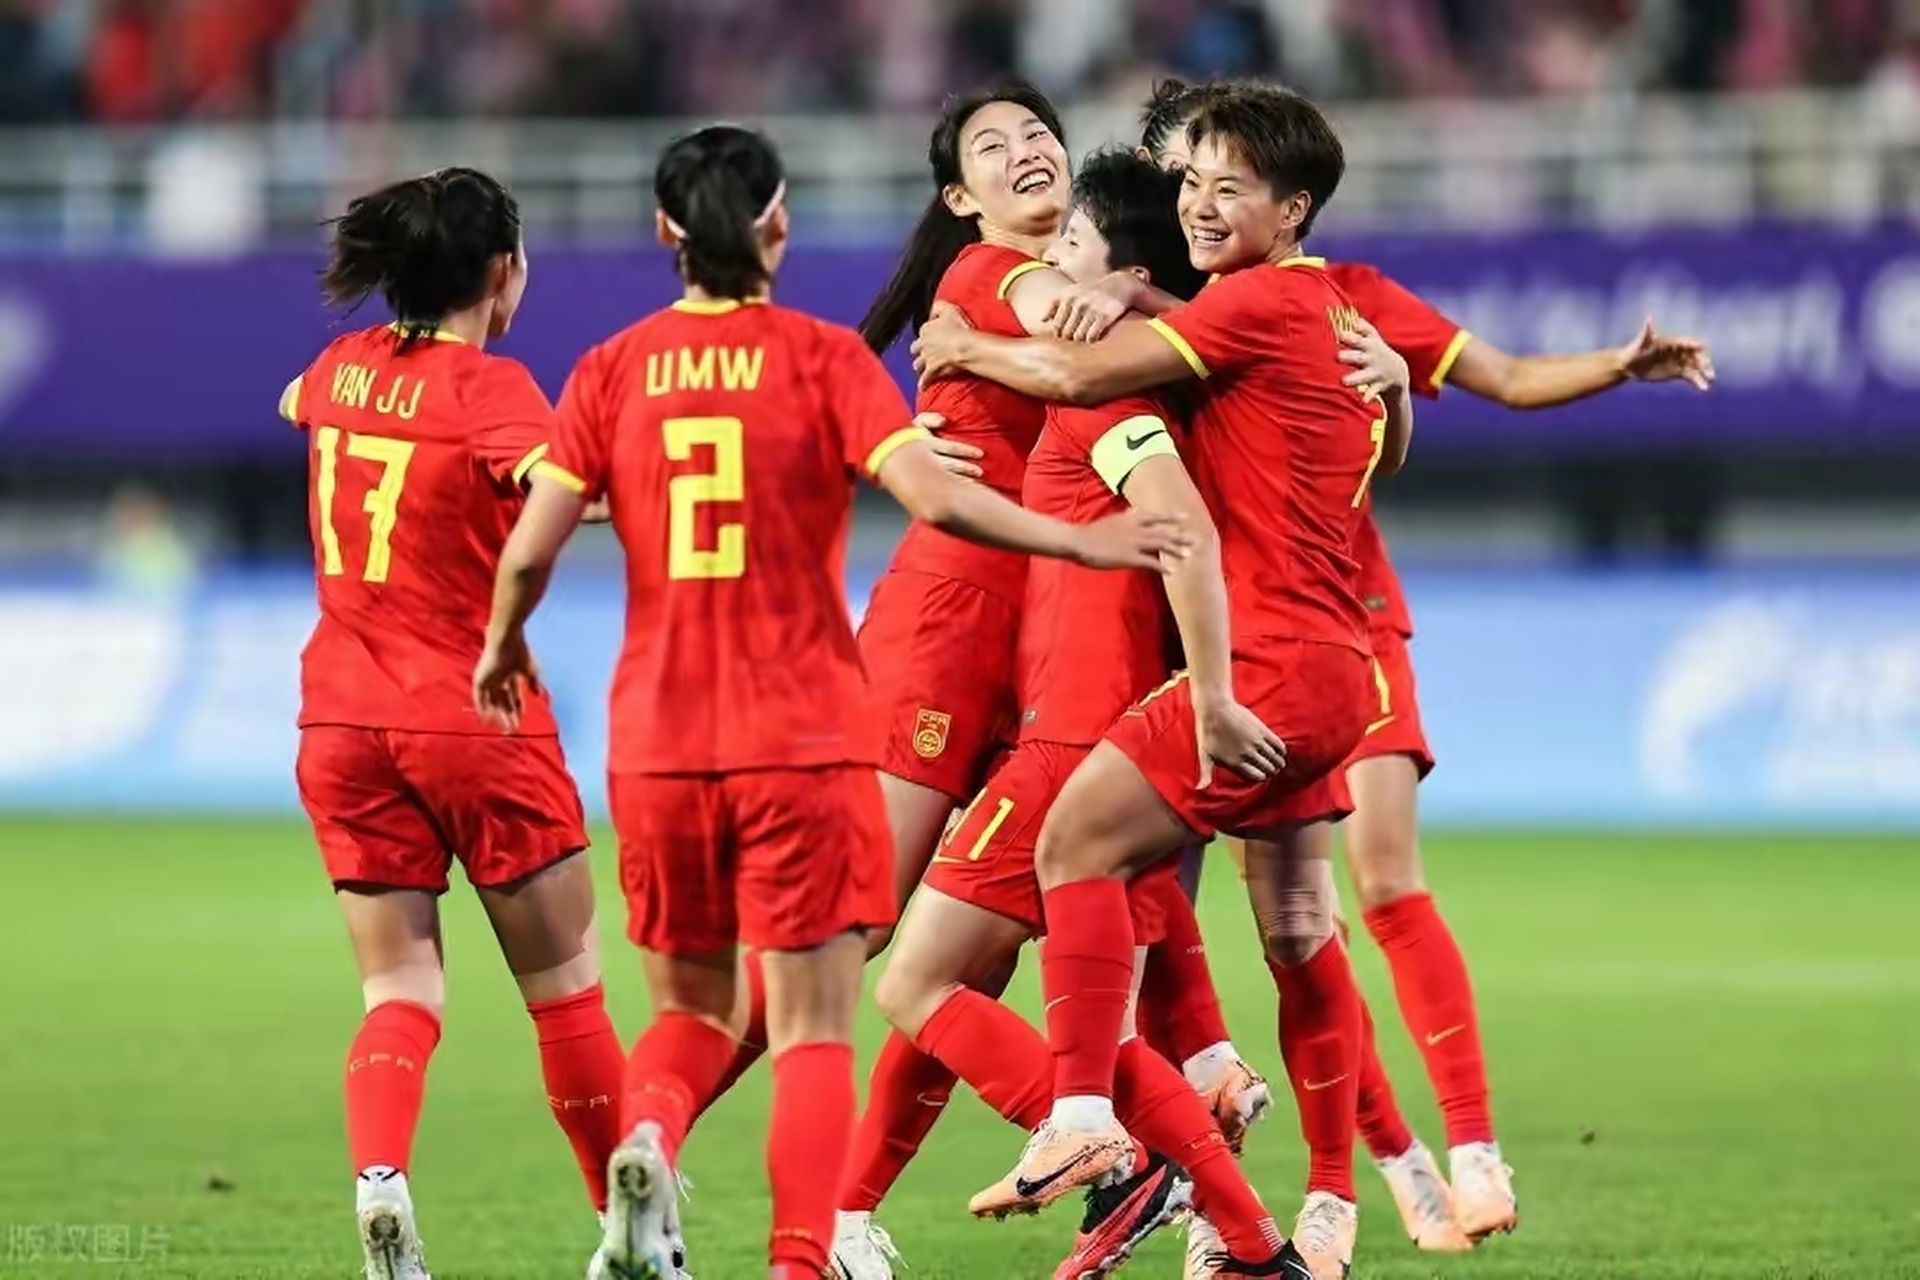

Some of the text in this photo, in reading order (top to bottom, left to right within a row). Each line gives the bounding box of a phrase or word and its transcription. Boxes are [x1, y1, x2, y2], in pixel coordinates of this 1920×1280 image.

[376, 375, 426, 420] JJ
[317, 426, 416, 583] 17
[662, 416, 746, 580] 2
